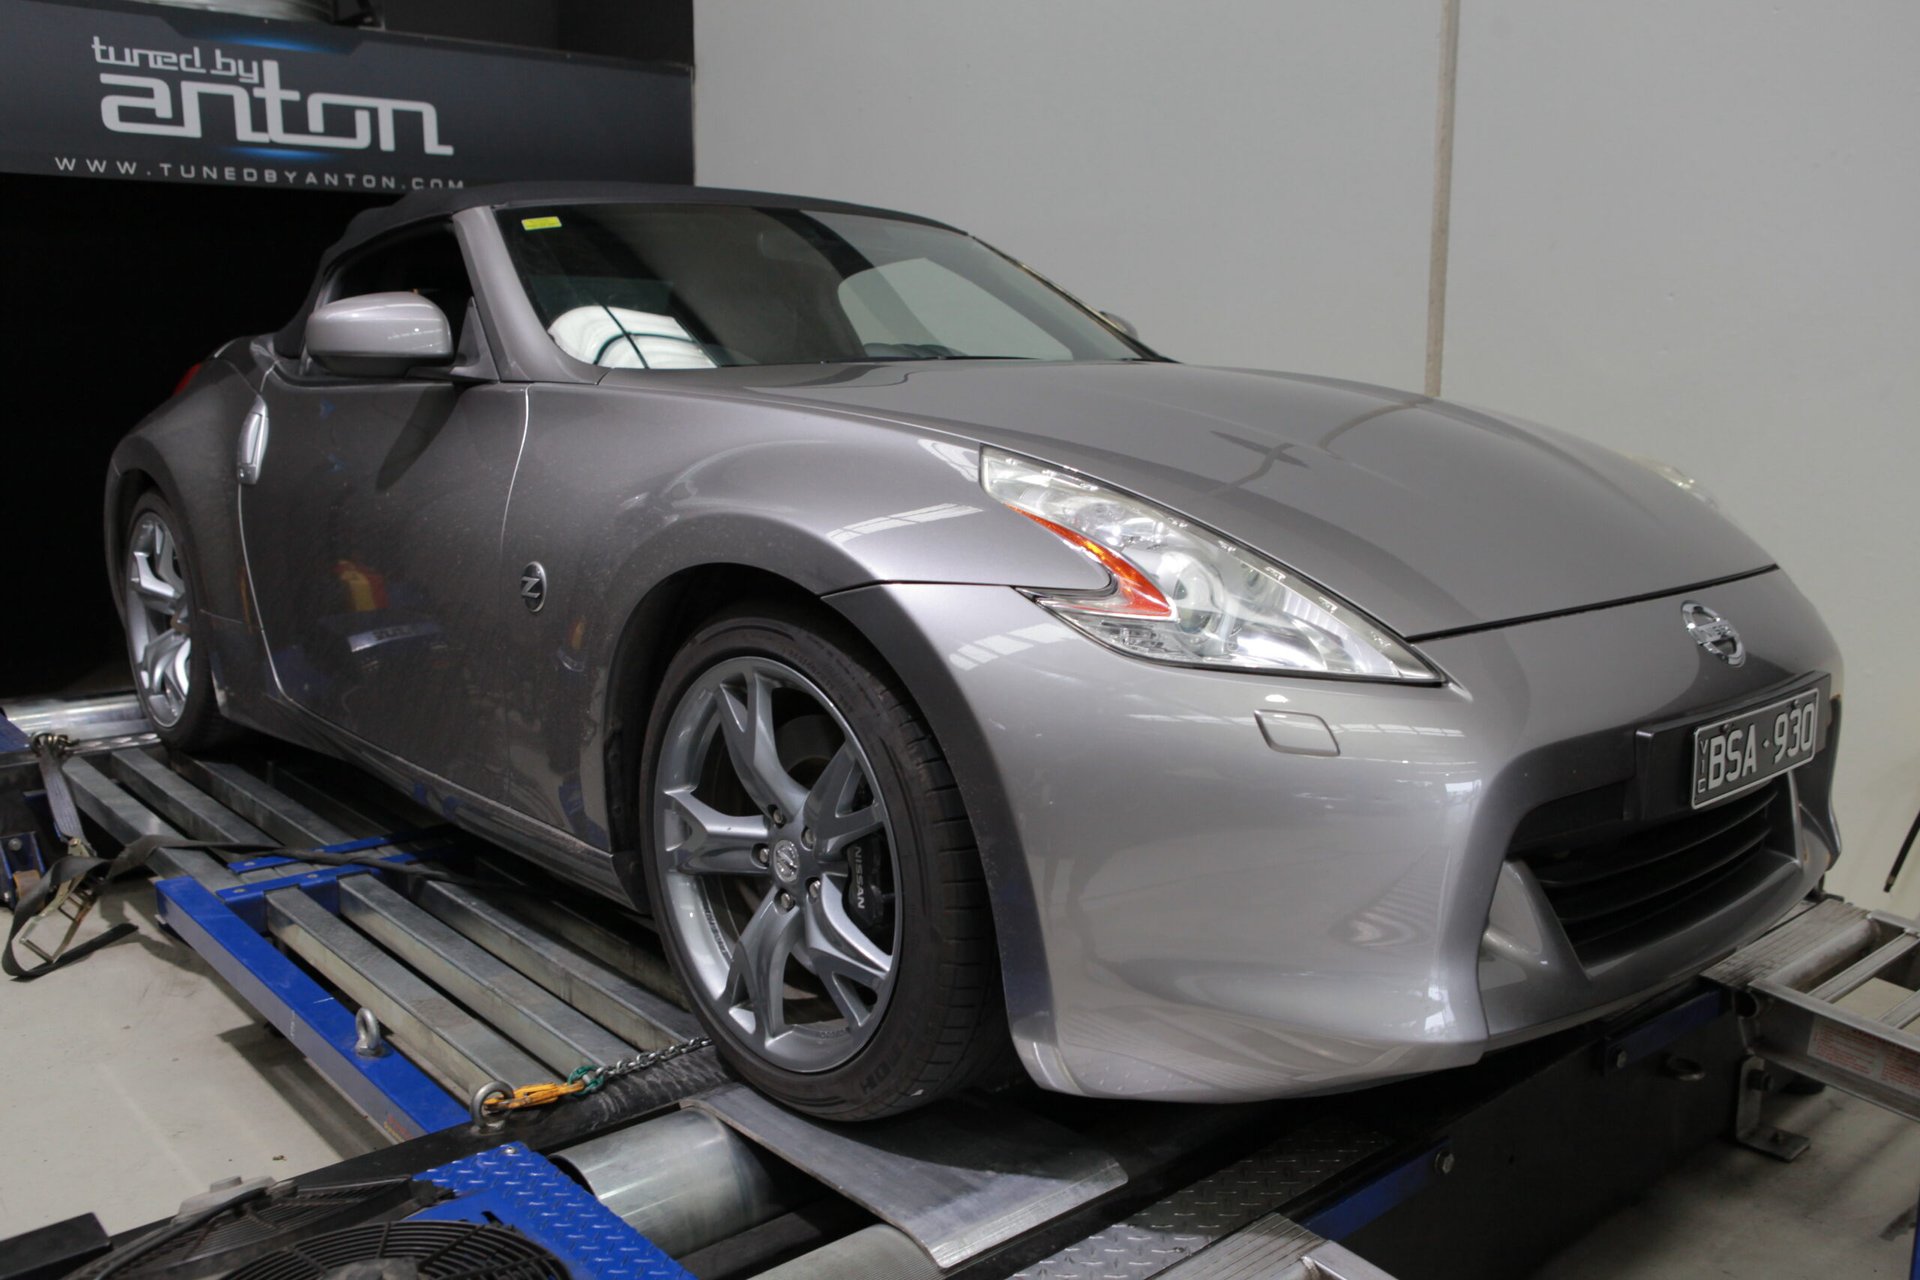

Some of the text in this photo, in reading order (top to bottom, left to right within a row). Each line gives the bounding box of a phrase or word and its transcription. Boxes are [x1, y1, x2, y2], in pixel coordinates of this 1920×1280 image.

[91, 36, 260, 84] tuned by
[100, 59, 454, 157] anton
[1697, 739, 1709, 793] VIC
[1708, 703, 1815, 790] BSA 930
[854, 846, 866, 909] NISSAN
